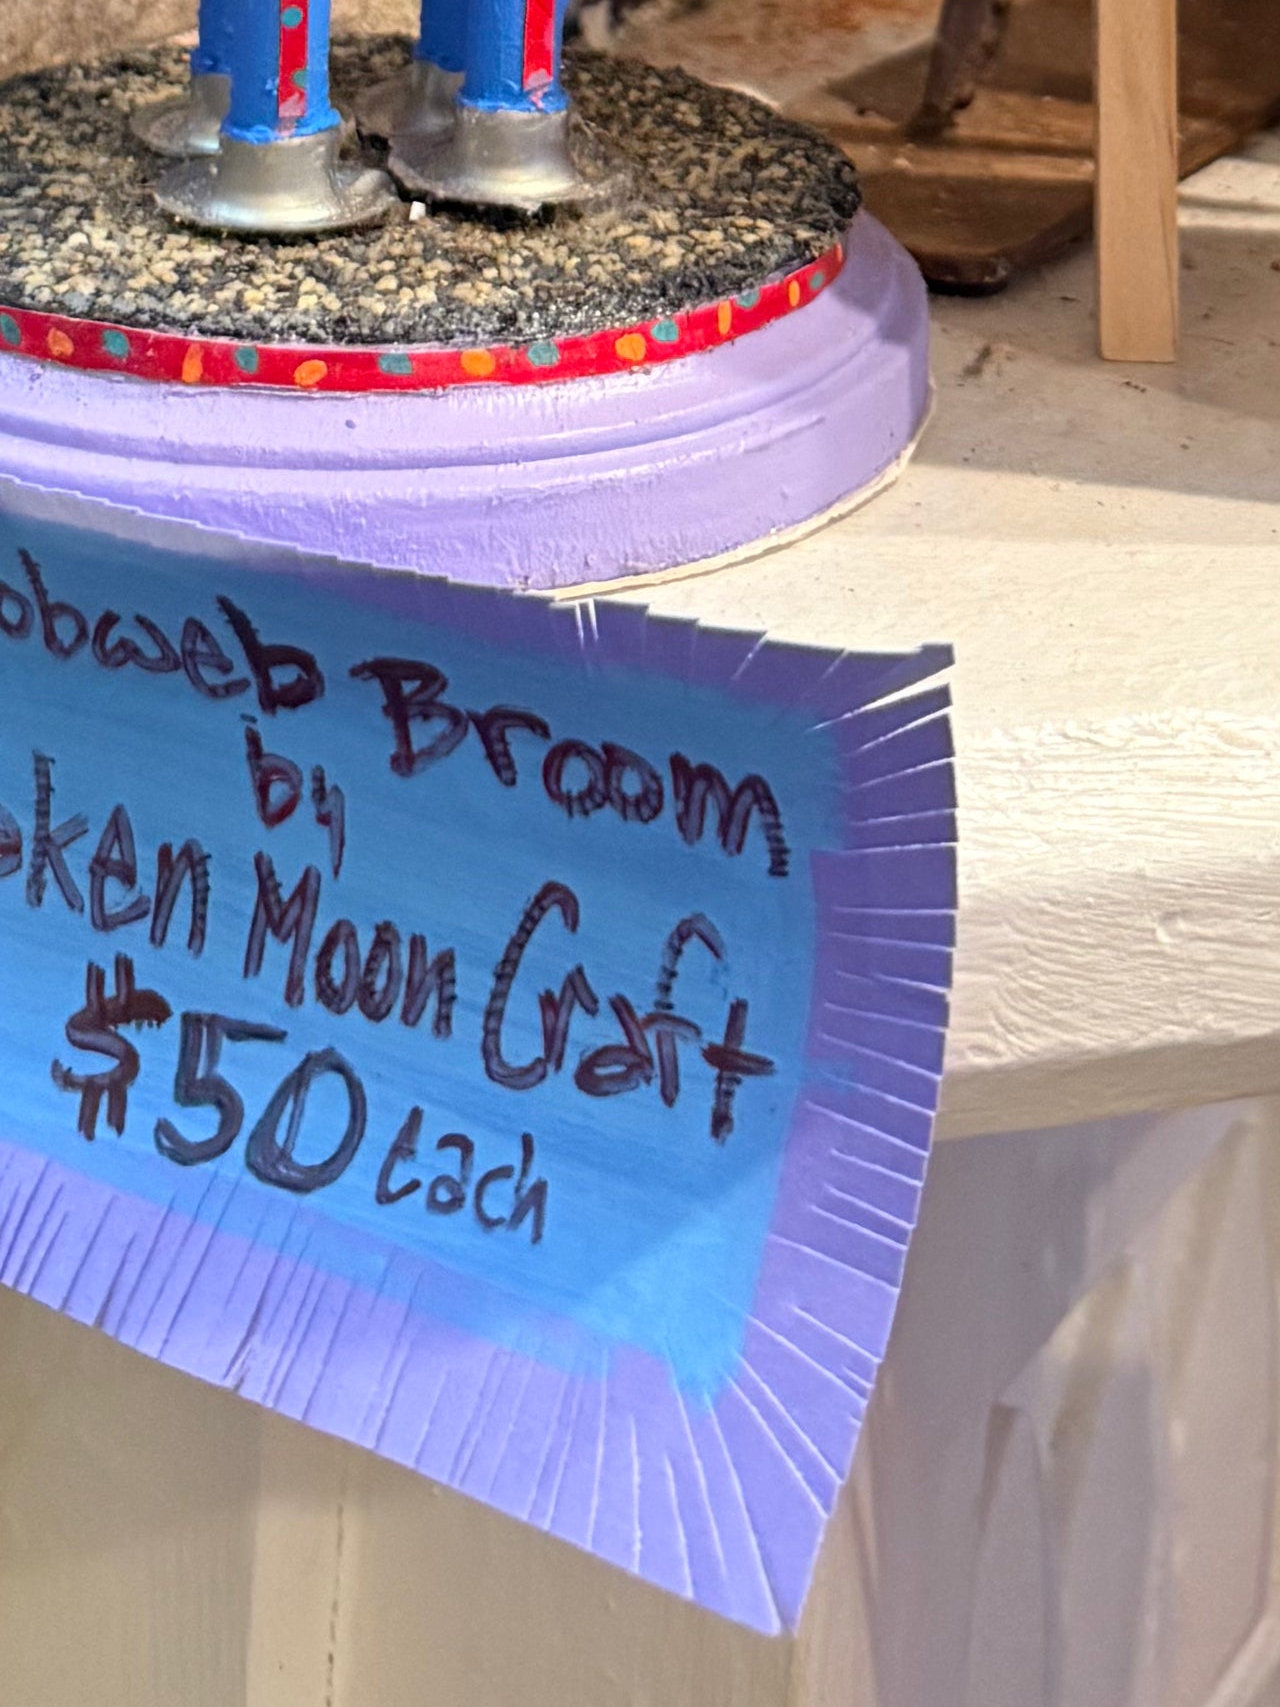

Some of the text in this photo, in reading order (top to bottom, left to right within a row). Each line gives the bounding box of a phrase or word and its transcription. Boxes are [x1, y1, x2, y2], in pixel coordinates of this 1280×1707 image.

[241, 713, 344, 879] by
[351, 657, 790, 874] Broom
[50, 954, 369, 1193] $50
[241, 852, 457, 1038] Moon
[482, 881, 774, 1142] Craft
